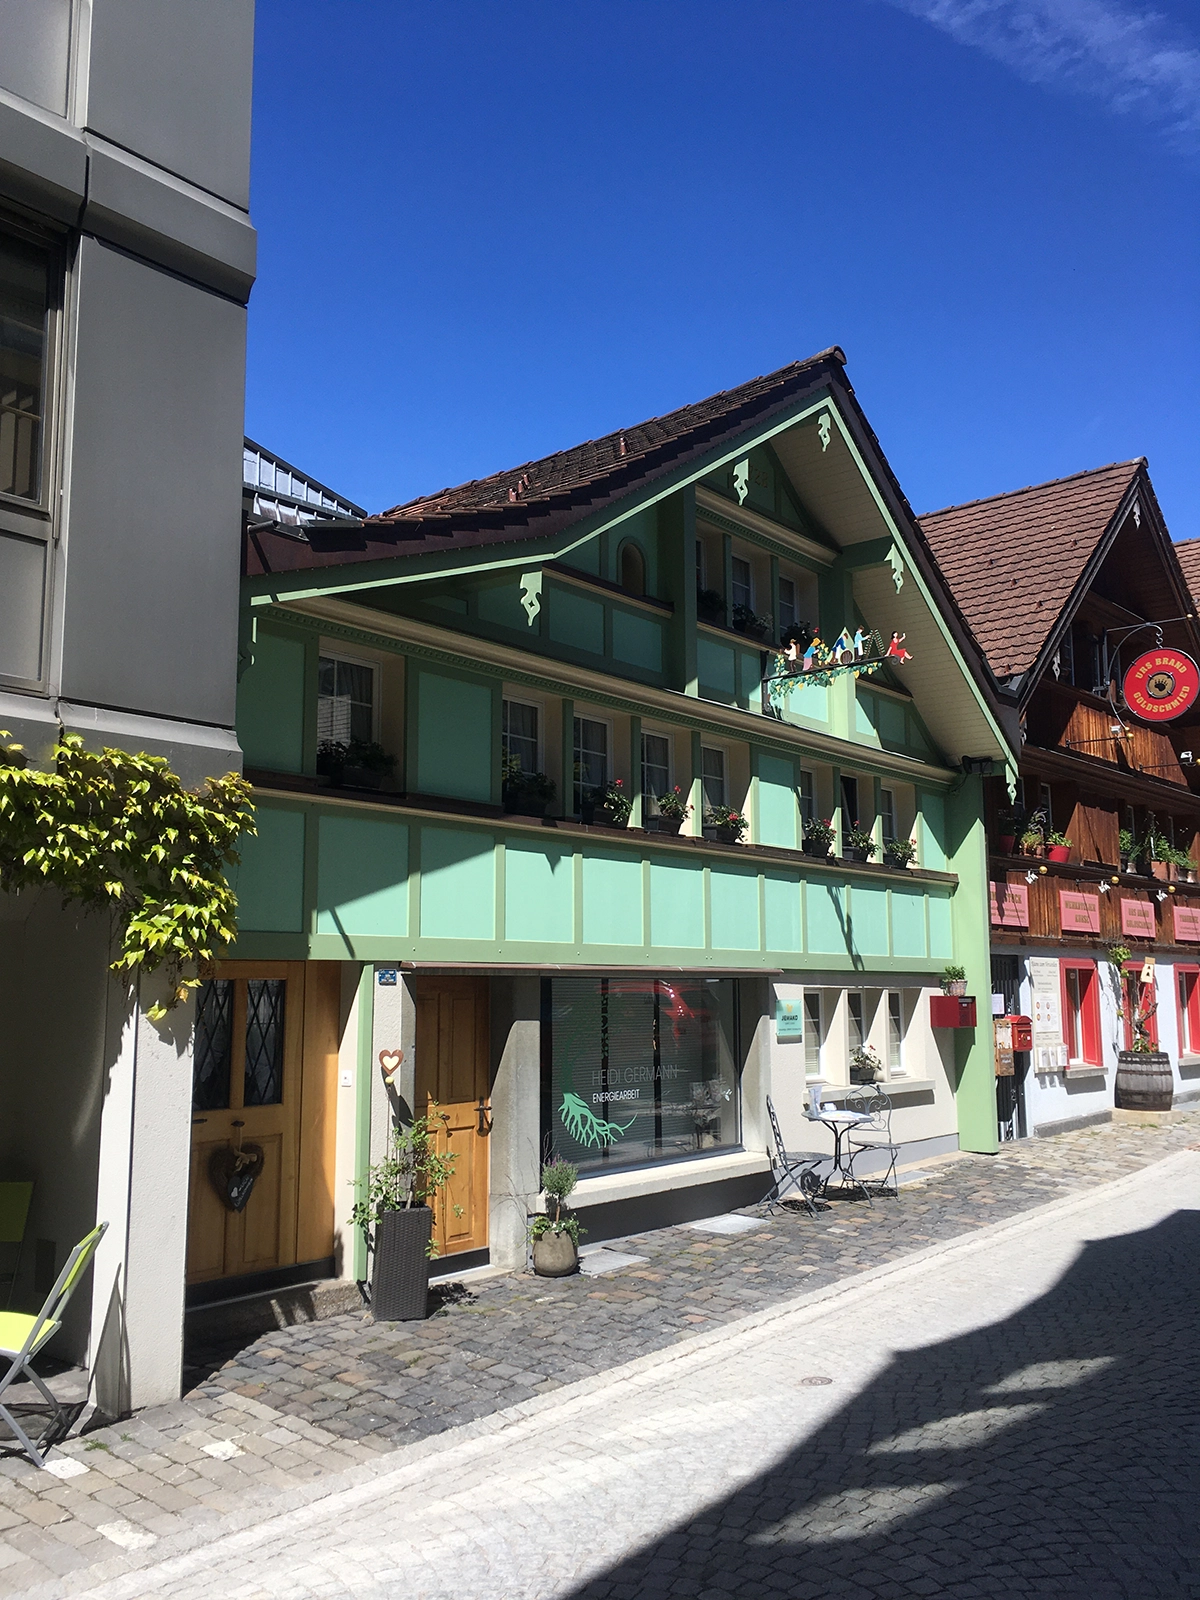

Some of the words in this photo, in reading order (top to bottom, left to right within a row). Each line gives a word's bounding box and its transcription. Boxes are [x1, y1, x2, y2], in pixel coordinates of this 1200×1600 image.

[1135, 661, 1153, 679] URS
[1155, 657, 1187, 674] BRAND
[1133, 685, 1190, 713] GOLDSCHMIED
[592, 1069, 621, 1086] HEIDI
[624, 1064, 678, 1084] GERMANN
[592, 1088, 640, 1104] ENERGIEARBEIT
